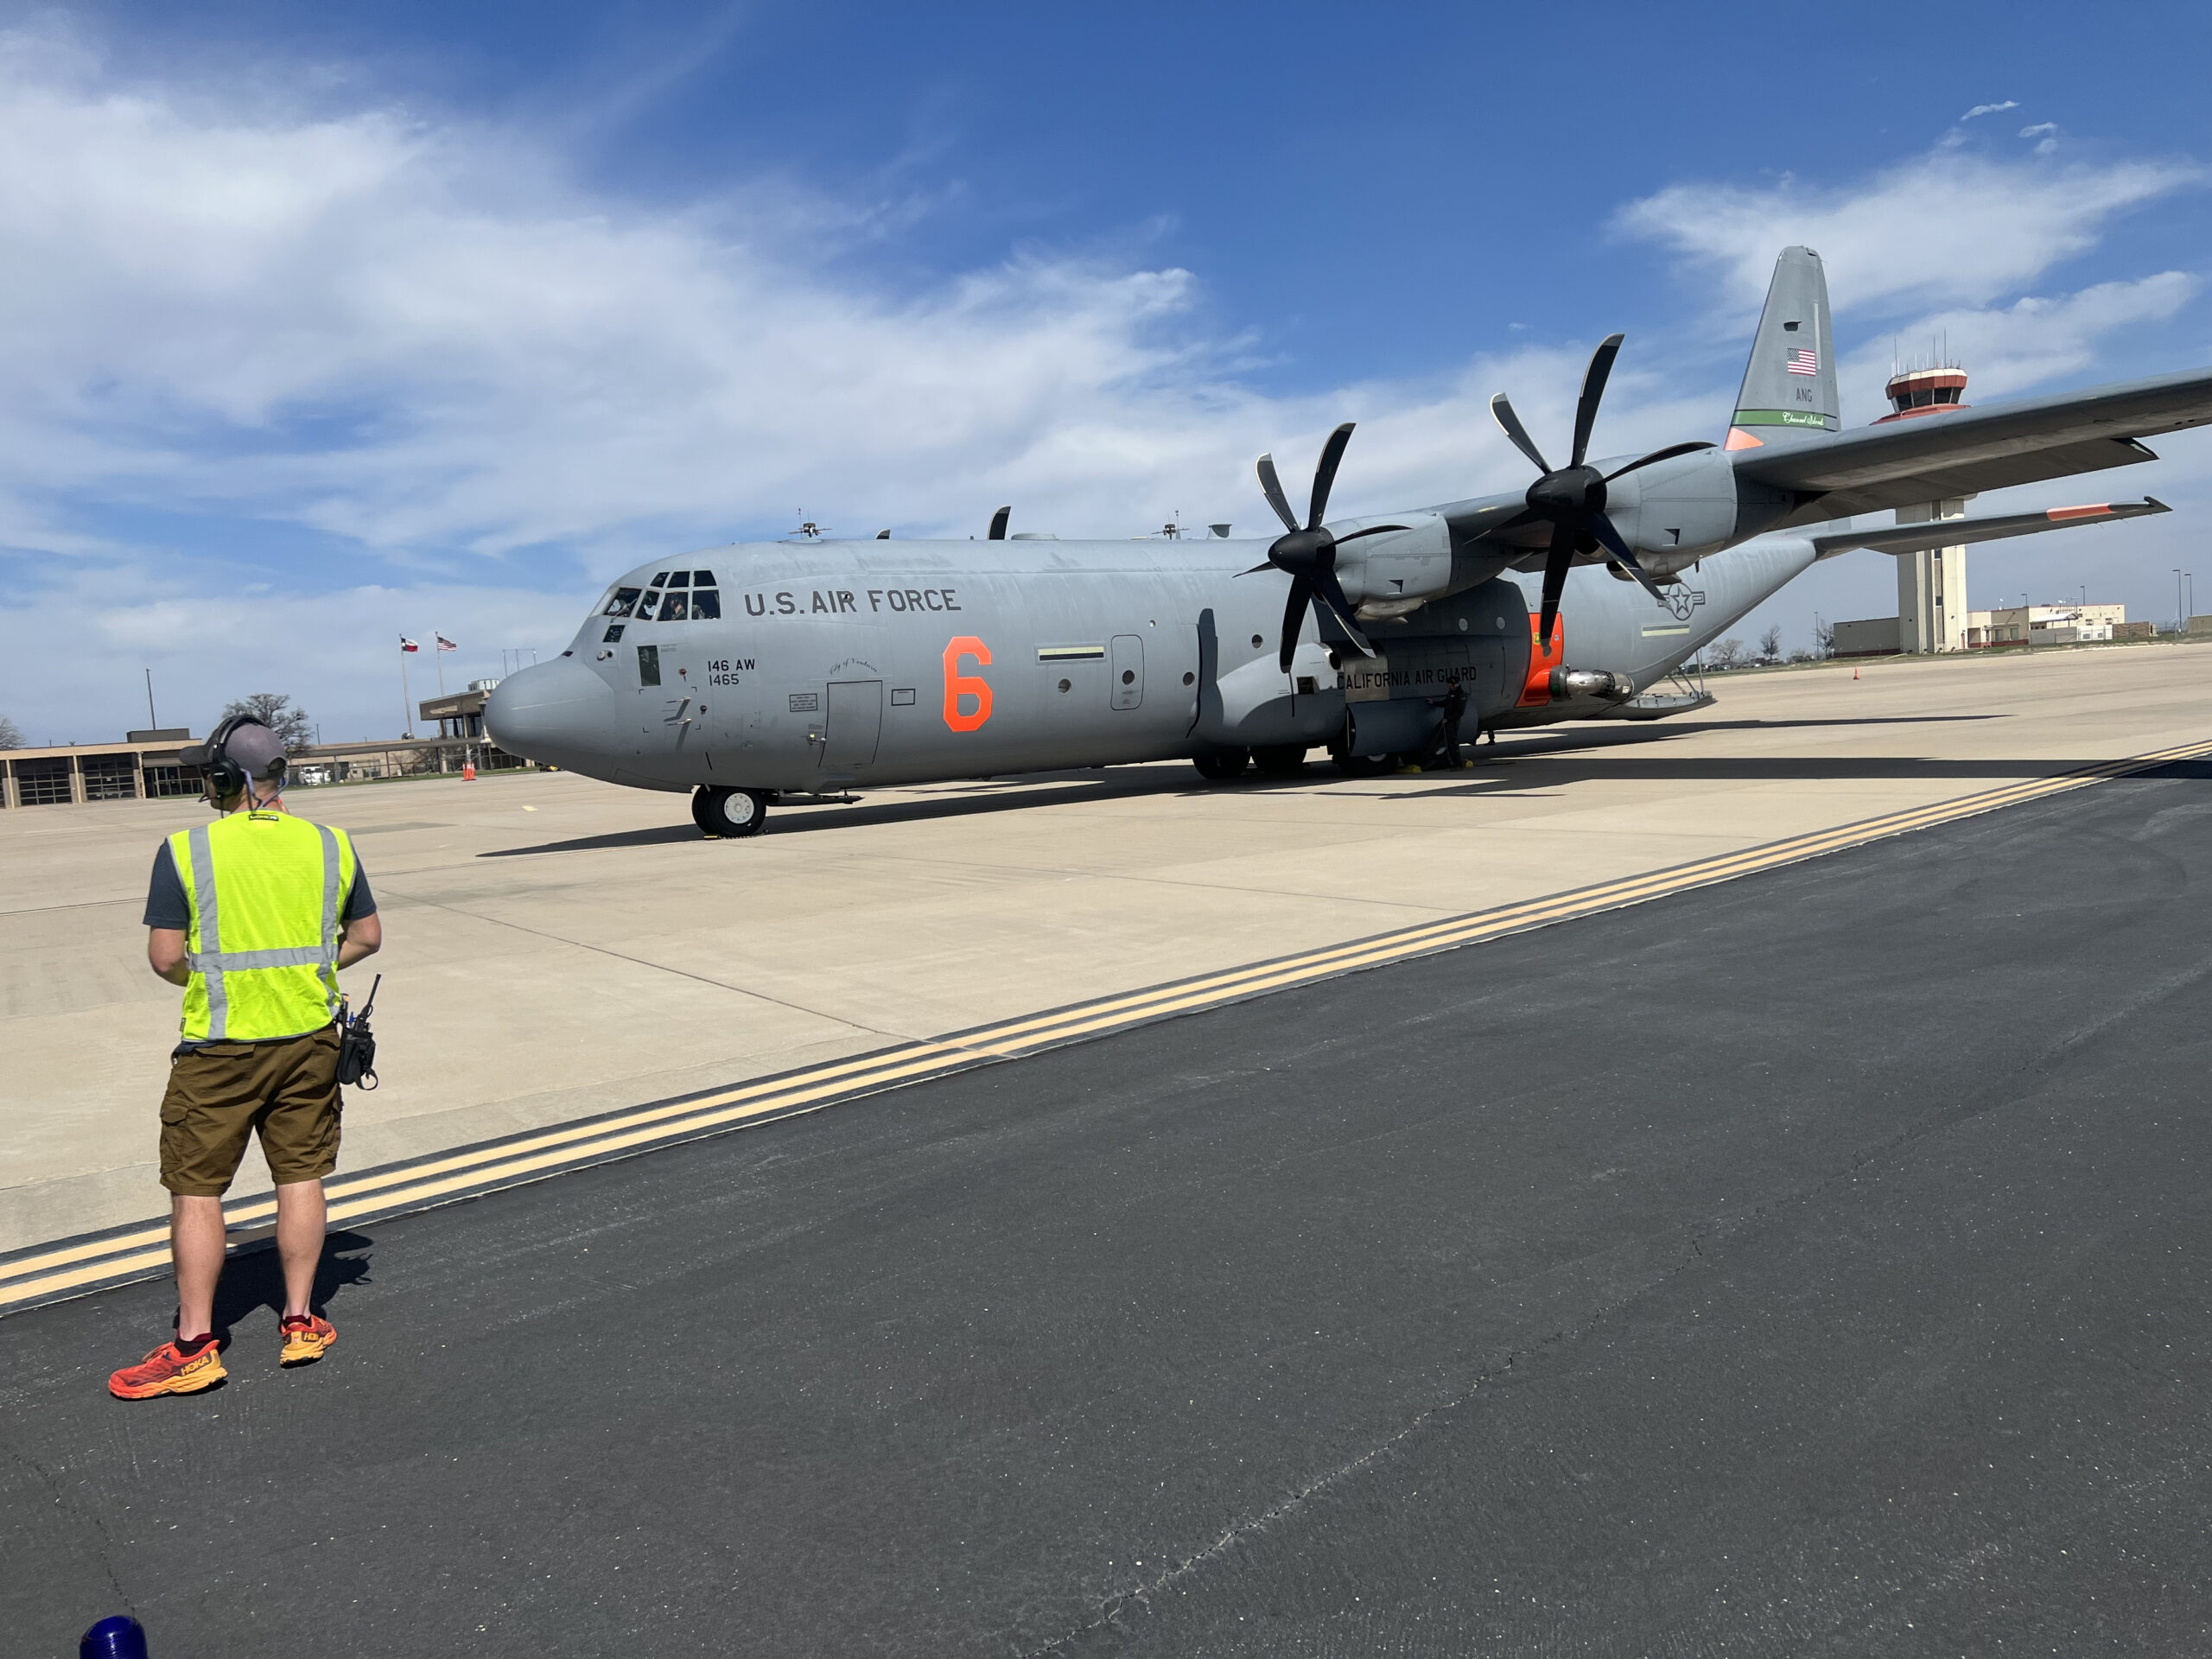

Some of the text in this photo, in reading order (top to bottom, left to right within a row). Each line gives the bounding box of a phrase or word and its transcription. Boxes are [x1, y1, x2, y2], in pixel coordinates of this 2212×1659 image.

[1796, 388, 1813, 403] ANG
[1783, 411, 1807, 423] Channel
[812, 590, 857, 613] AIR
[867, 589, 962, 613] FORCE
[708, 658, 755, 672] 146 AW
[709, 673, 740, 686] 1465
[943, 636, 993, 733] 6
[1337, 666, 1477, 690] CALIFORNIA AIR GUARD
[181, 1356, 210, 1376] HOKA
